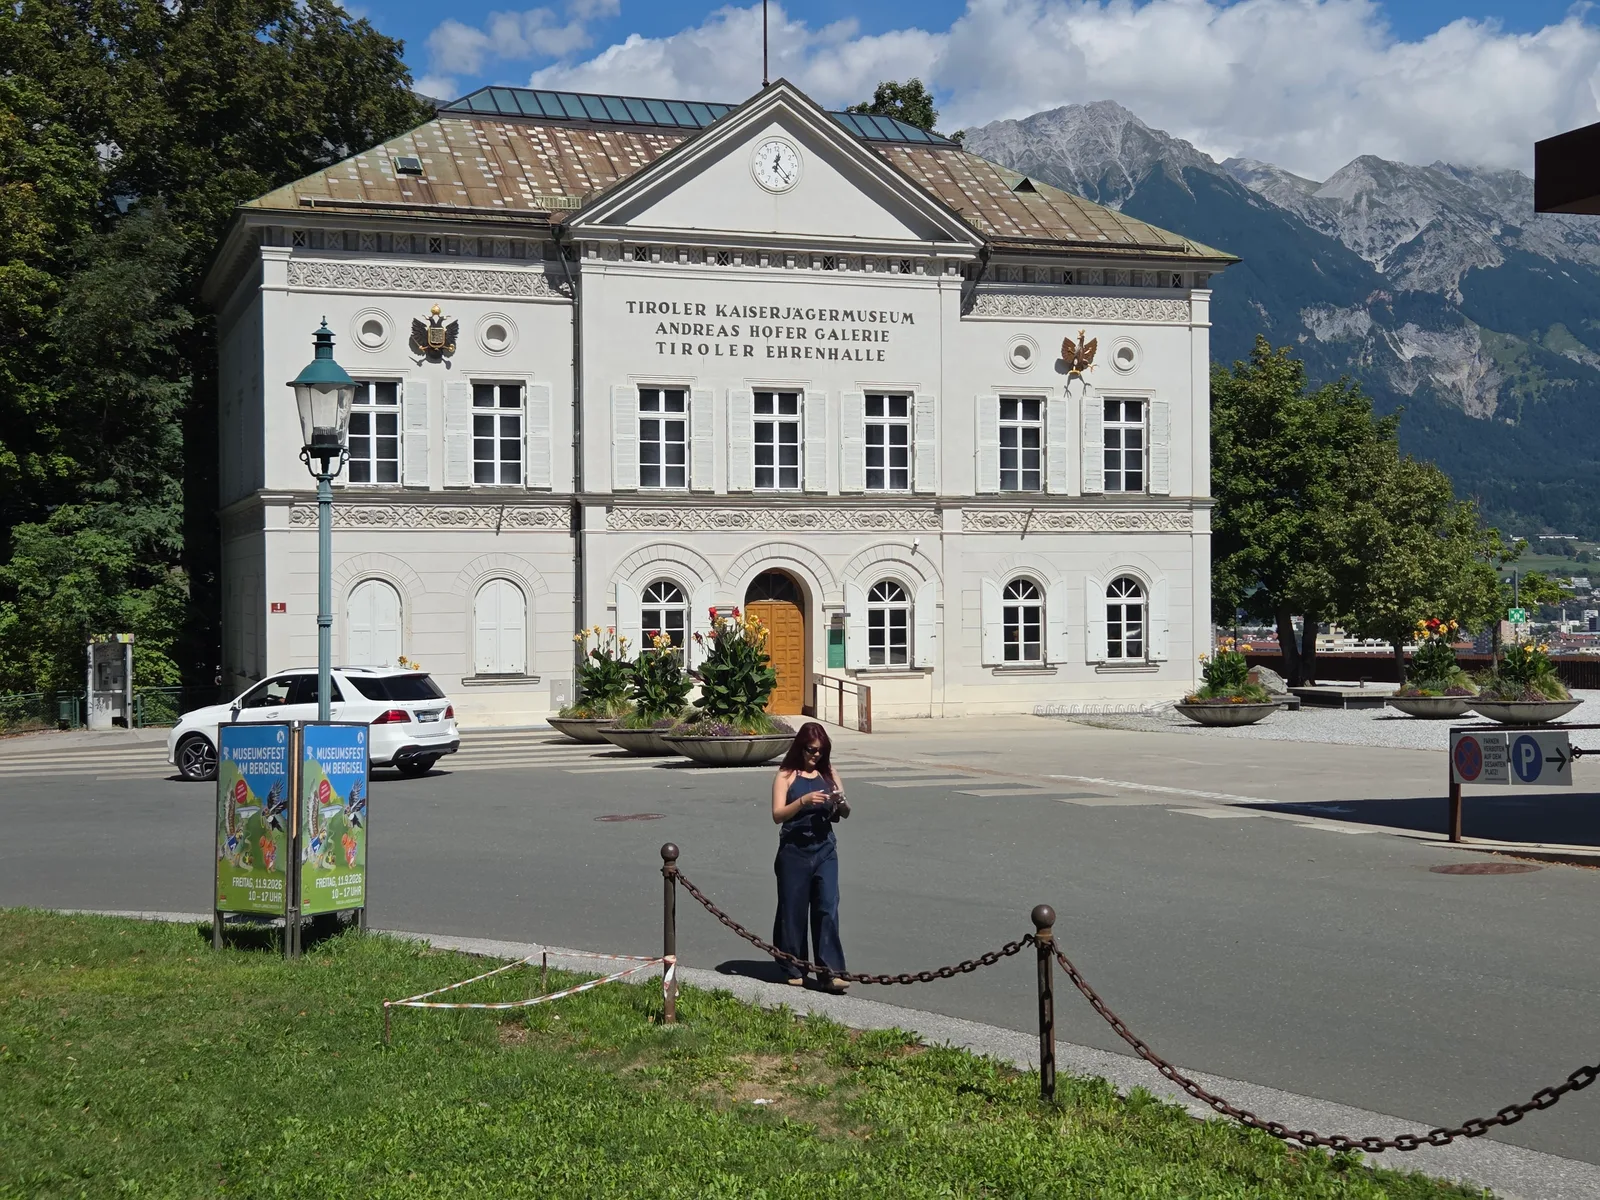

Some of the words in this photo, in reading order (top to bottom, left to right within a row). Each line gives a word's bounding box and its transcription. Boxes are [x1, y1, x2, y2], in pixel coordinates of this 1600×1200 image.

[626, 300, 706, 316] TIROLER
[715, 304, 915, 325] KAISERJÄGERMUSEUM
[655, 321, 740, 337] ANDREAS
[749, 325, 807, 340] HOFER
[814, 328, 890, 343] GALERIE
[656, 341, 754, 357] TIROLER
[766, 345, 886, 362] EHRENHALLE
[232, 747, 285, 760] MUSEUMSFEST
[316, 747, 364, 760] MUSEUMSFEST
[1520, 743, 1536, 777] P
[237, 762, 248, 774] AM
[249, 762, 285, 774] BERGISEL
[321, 762, 332, 774] AM
[332, 762, 364, 774] BERGISEL
[232, 877, 254, 889] FREITAG,
[315, 876, 337, 888] FREITAG,
[248, 891, 257, 901] 10
[261, 892, 269, 902] 17
[270, 892, 282, 902] UHR
[332, 888, 339, 899] 10
[343, 887, 350, 897] 17
[350, 886, 362, 896] UHR
